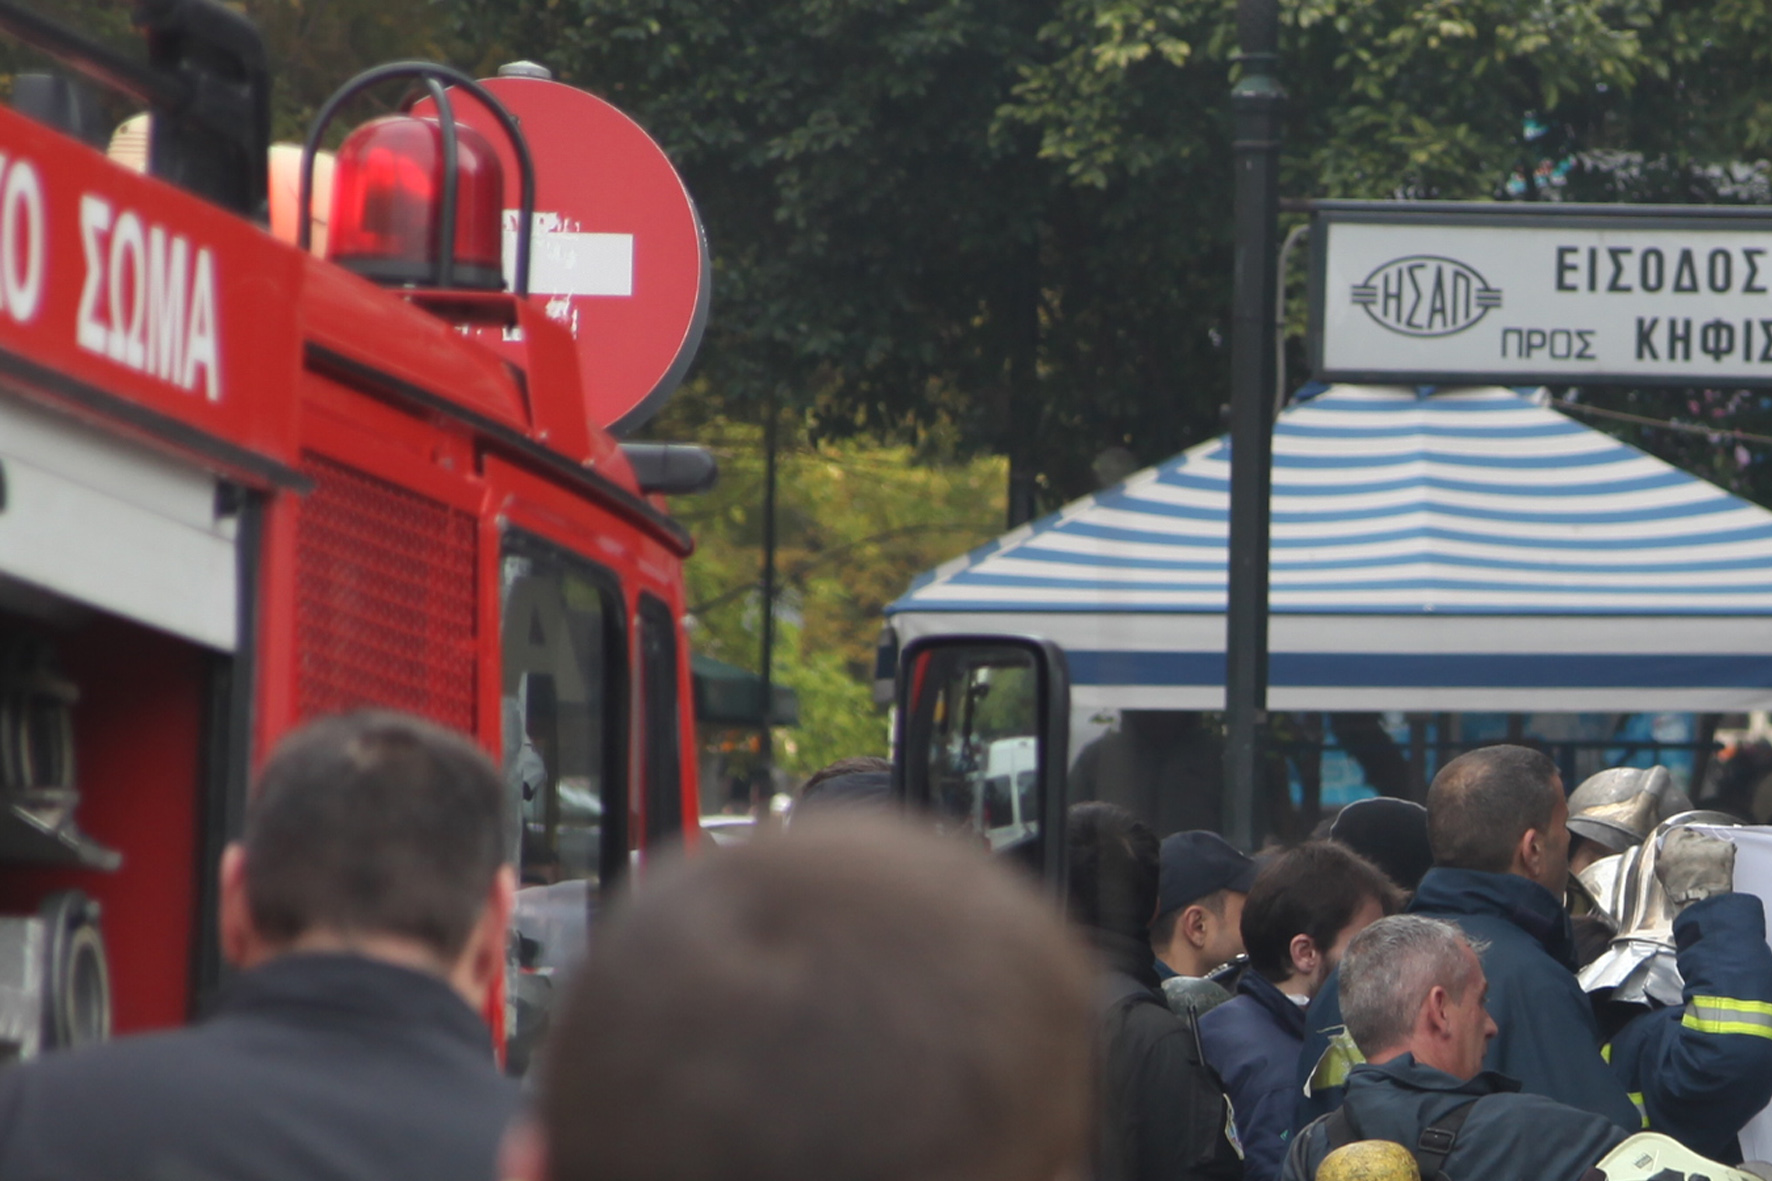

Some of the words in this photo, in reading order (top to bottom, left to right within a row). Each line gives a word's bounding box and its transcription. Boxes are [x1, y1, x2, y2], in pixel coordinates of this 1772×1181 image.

[1382, 263, 1470, 329] ΗΣΑΠ
[1556, 246, 1768, 293] ΕΙΣΟΔΟΣ
[76, 194, 221, 403] ΣΩΜΑ
[1502, 327, 1597, 360] ΠΡΟΣ
